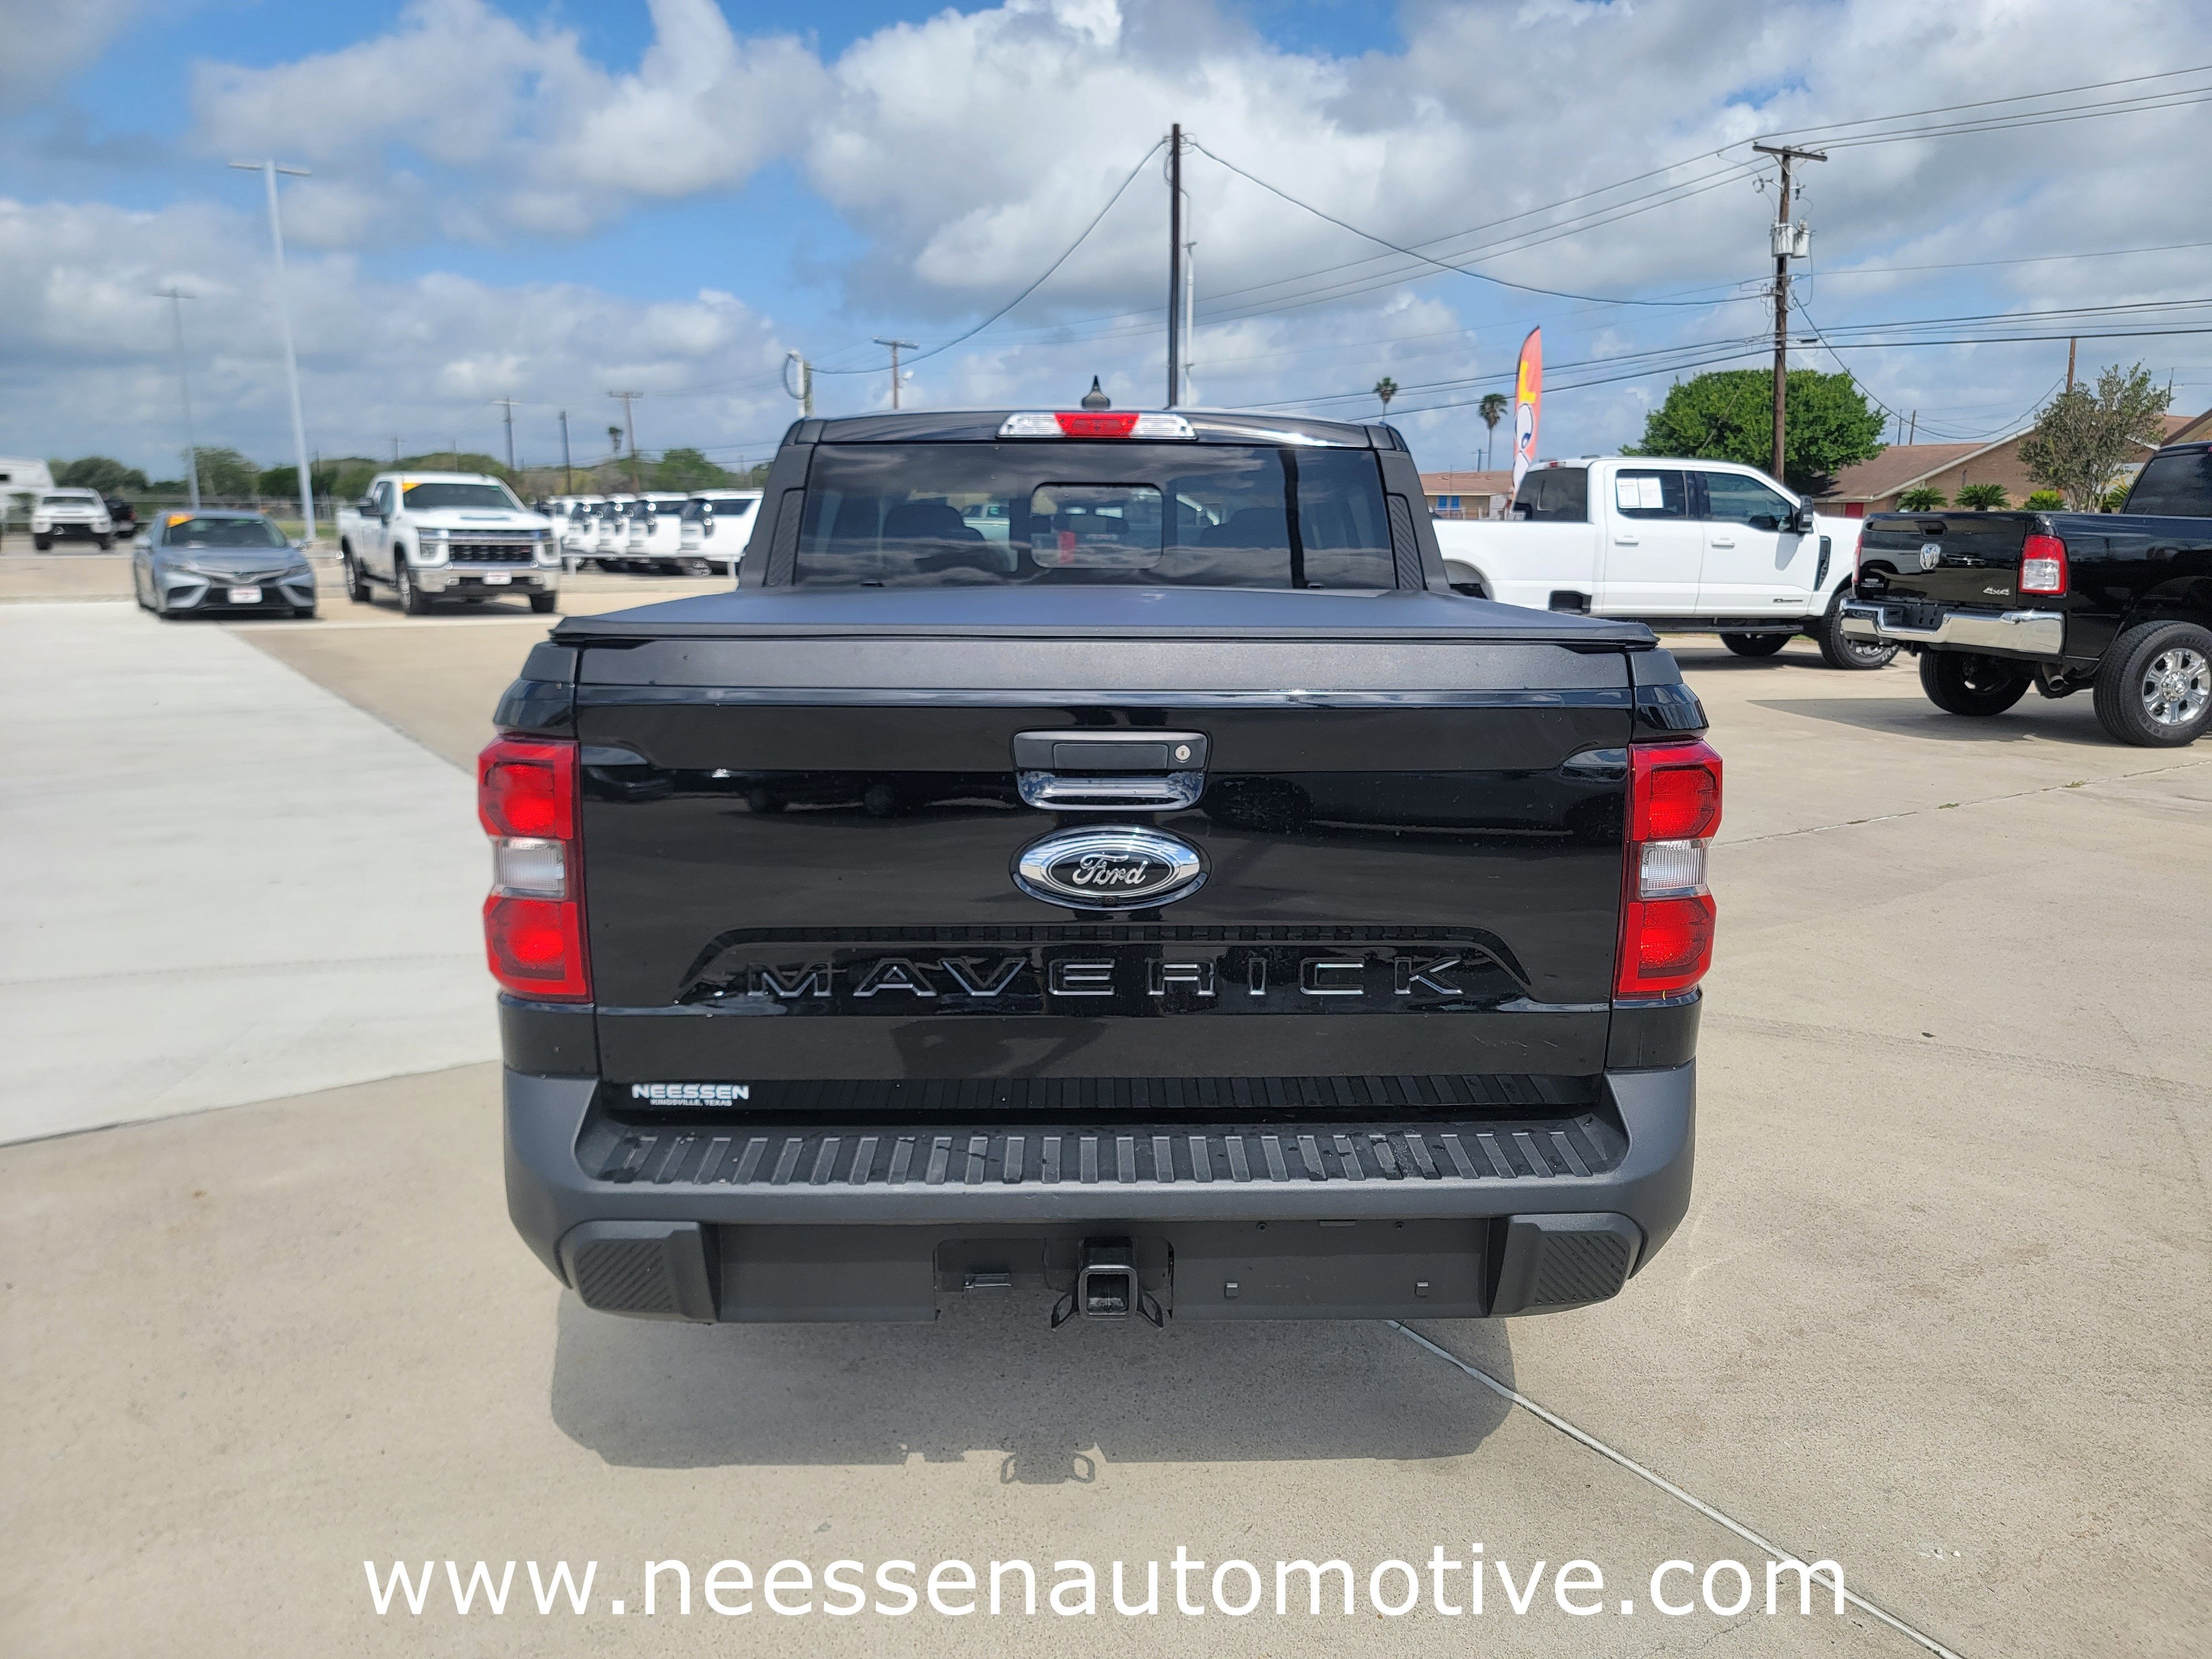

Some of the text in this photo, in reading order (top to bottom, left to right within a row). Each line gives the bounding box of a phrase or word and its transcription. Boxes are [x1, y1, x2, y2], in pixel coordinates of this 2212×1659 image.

[1072, 853, 1149, 885] Ford
[747, 957, 1463, 996] MAVERICK
[632, 1084, 749, 1099] NEESSEN
